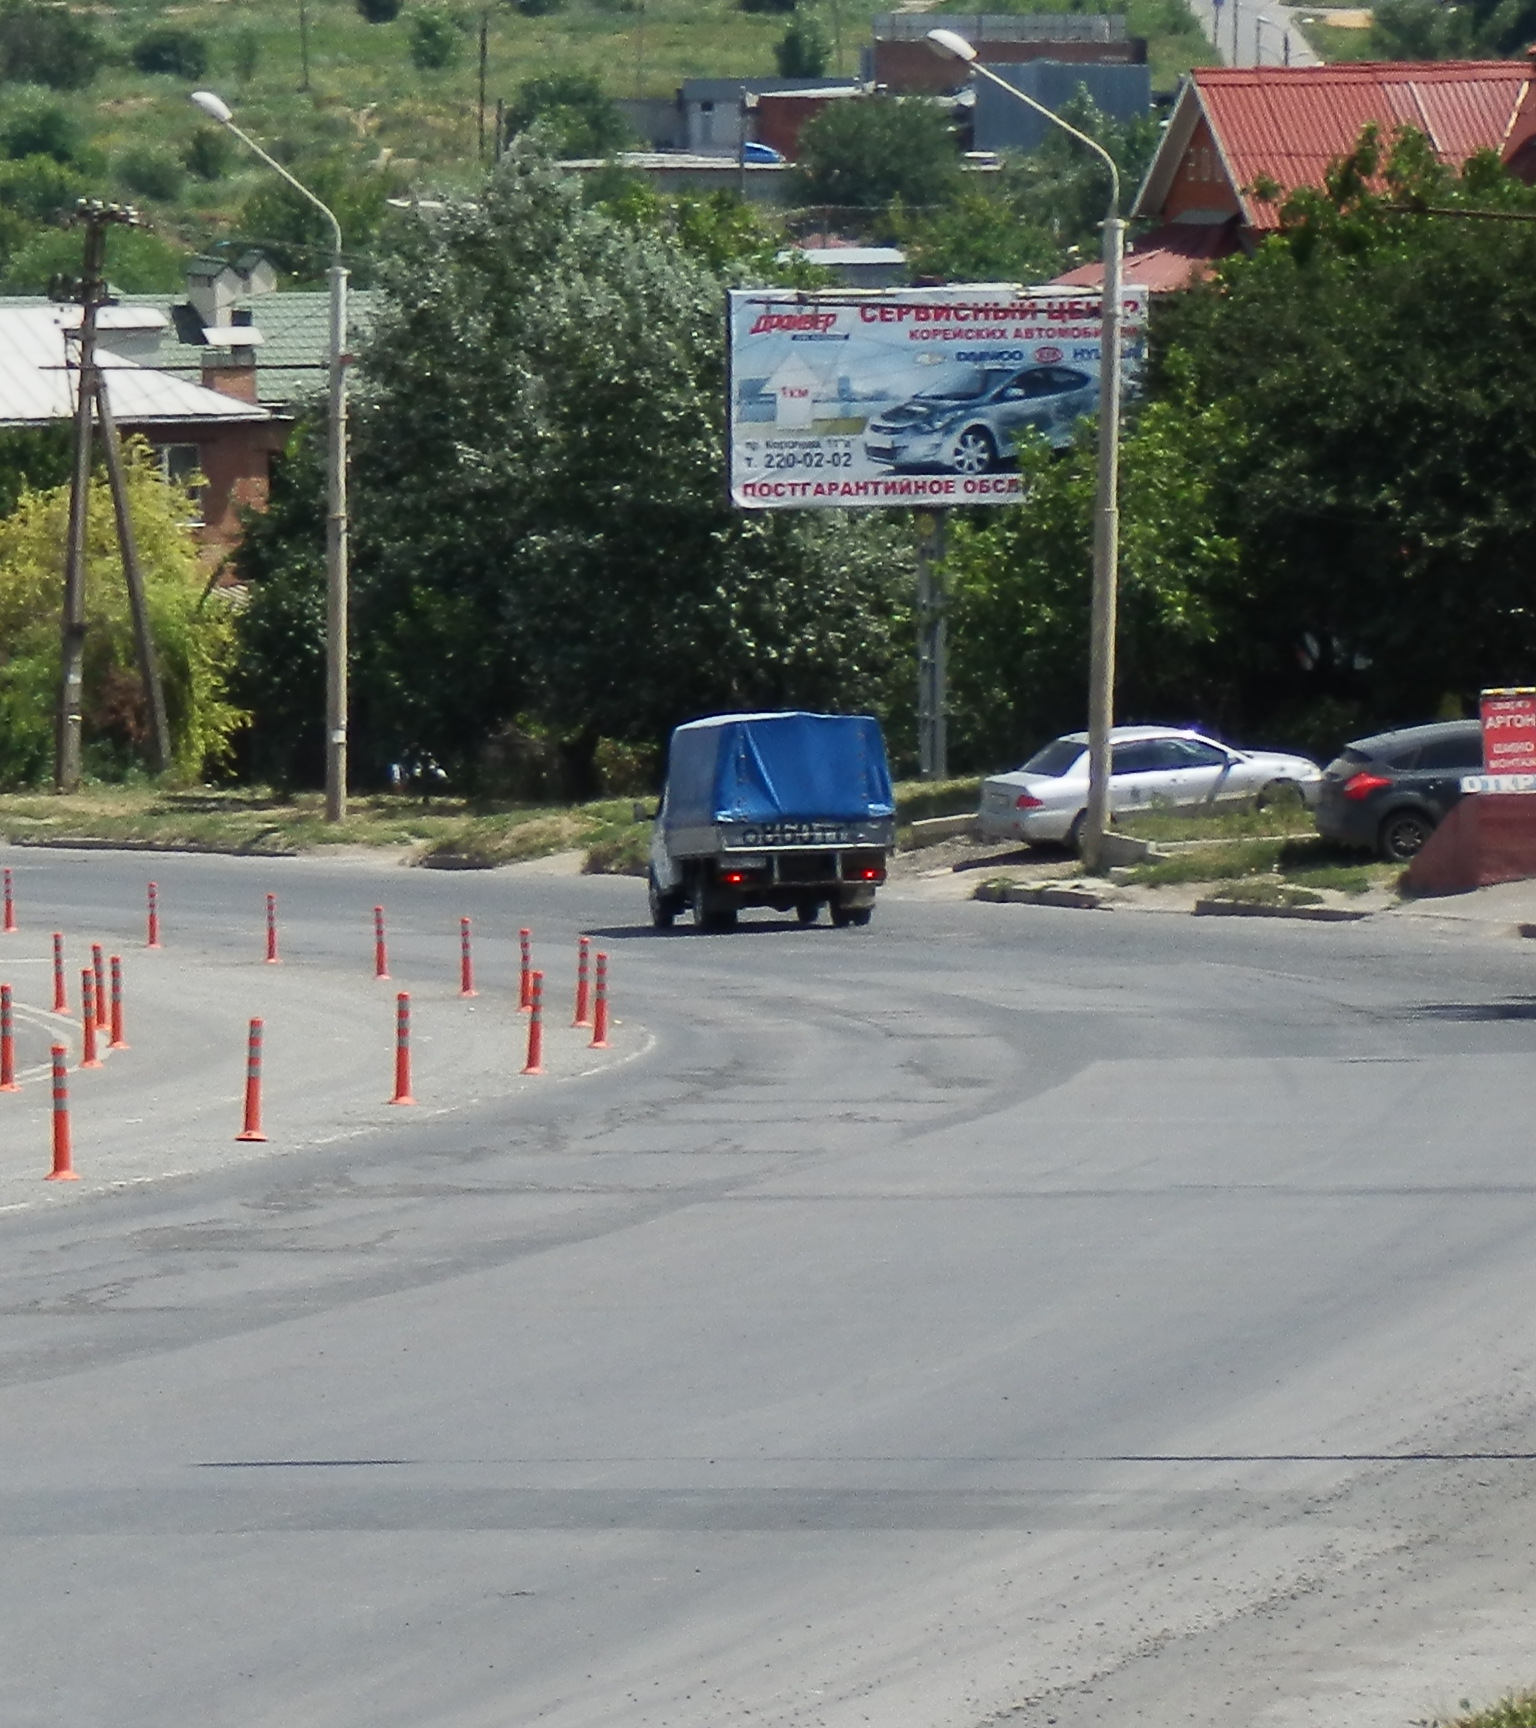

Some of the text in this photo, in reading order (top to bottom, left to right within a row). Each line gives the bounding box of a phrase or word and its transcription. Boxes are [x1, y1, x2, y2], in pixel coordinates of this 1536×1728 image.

[909, 326, 1008, 341] КОРЕЙСКИХ
[764, 452, 853, 469] 220-02-02
[743, 479, 956, 498] ПОСТГАРАНТИЙНОЕ
[1486, 714, 1536, 729] АРГОН
